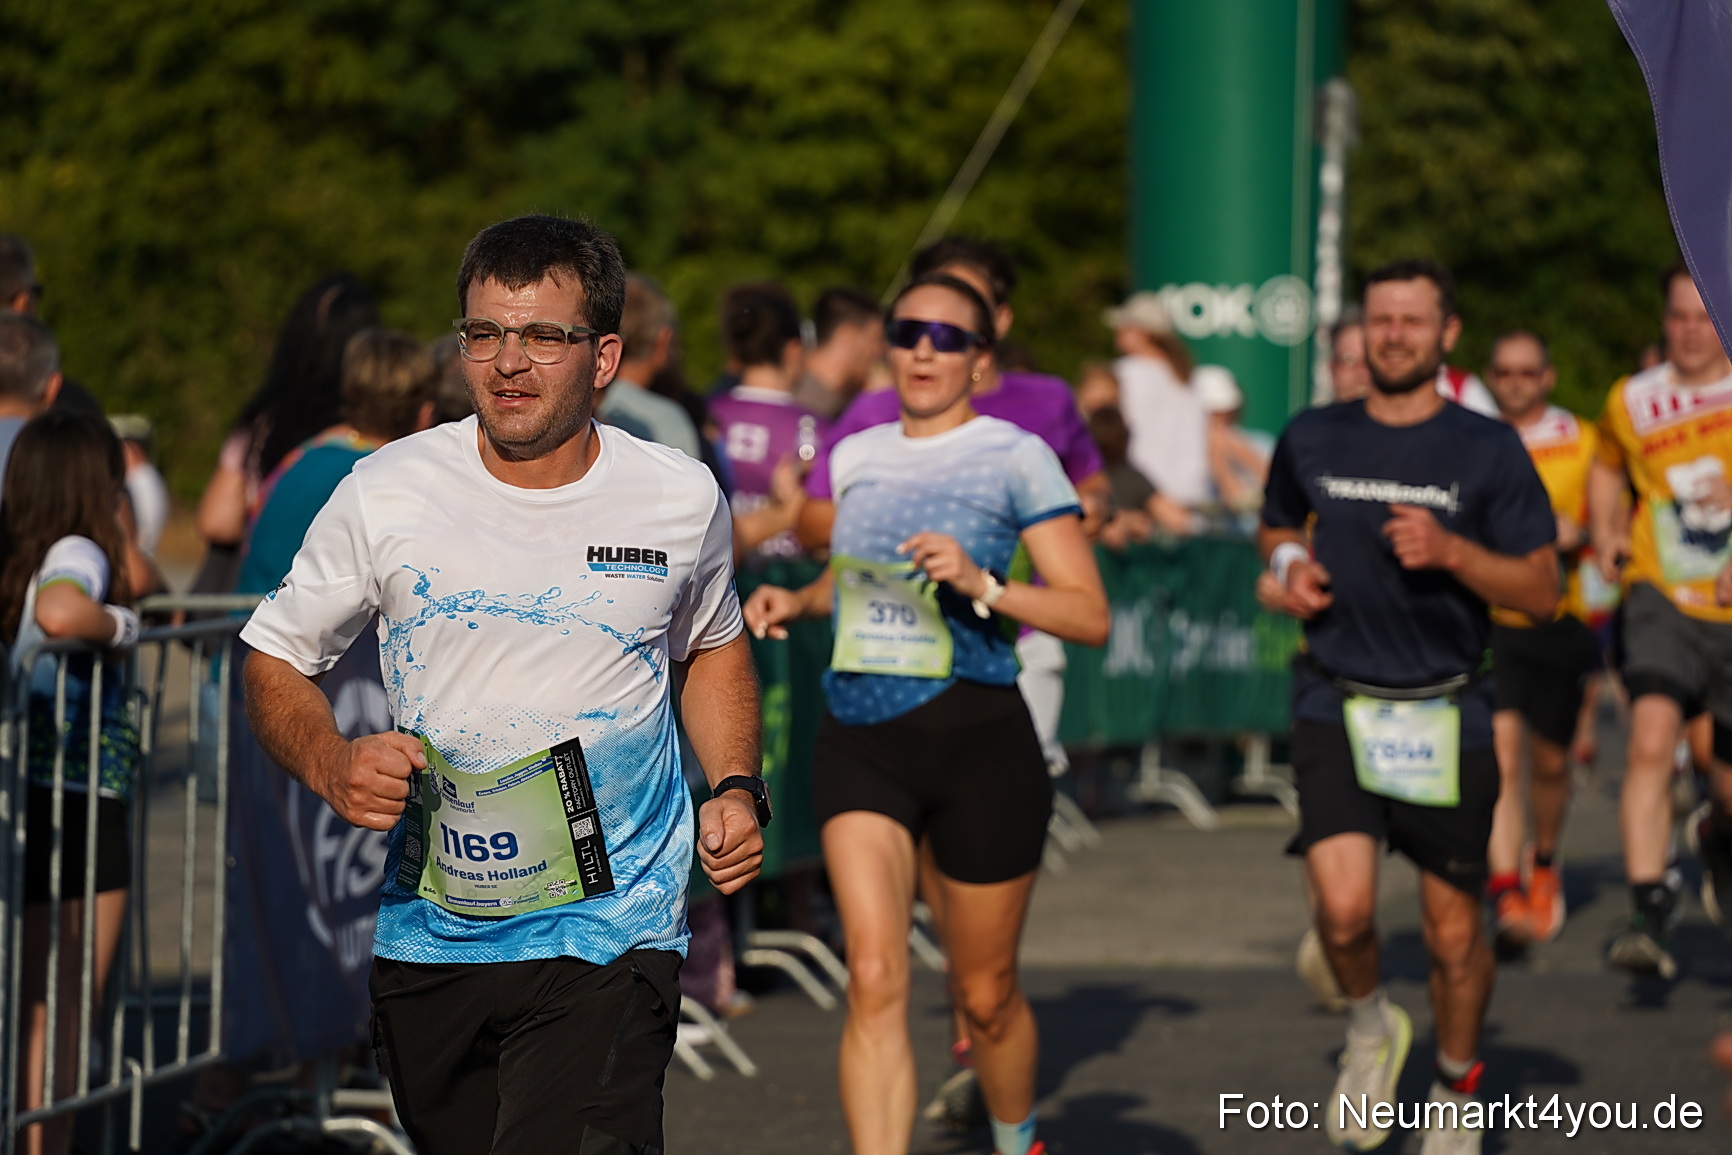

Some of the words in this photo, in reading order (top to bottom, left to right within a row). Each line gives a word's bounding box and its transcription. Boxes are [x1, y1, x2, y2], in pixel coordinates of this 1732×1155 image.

[587, 546, 668, 567] HUBER
[605, 564, 666, 575] TECHNOLOGY
[867, 600, 917, 628] 370
[554, 755, 571, 792] RABATT
[563, 752, 575, 779] OUTLET
[563, 790, 571, 800] %
[565, 800, 575, 813] 20
[569, 780, 583, 810] FACTORY
[439, 821, 519, 862] 1169
[436, 855, 484, 881] Andreas
[487, 859, 548, 881] Holland
[581, 840, 599, 885] HILTL
